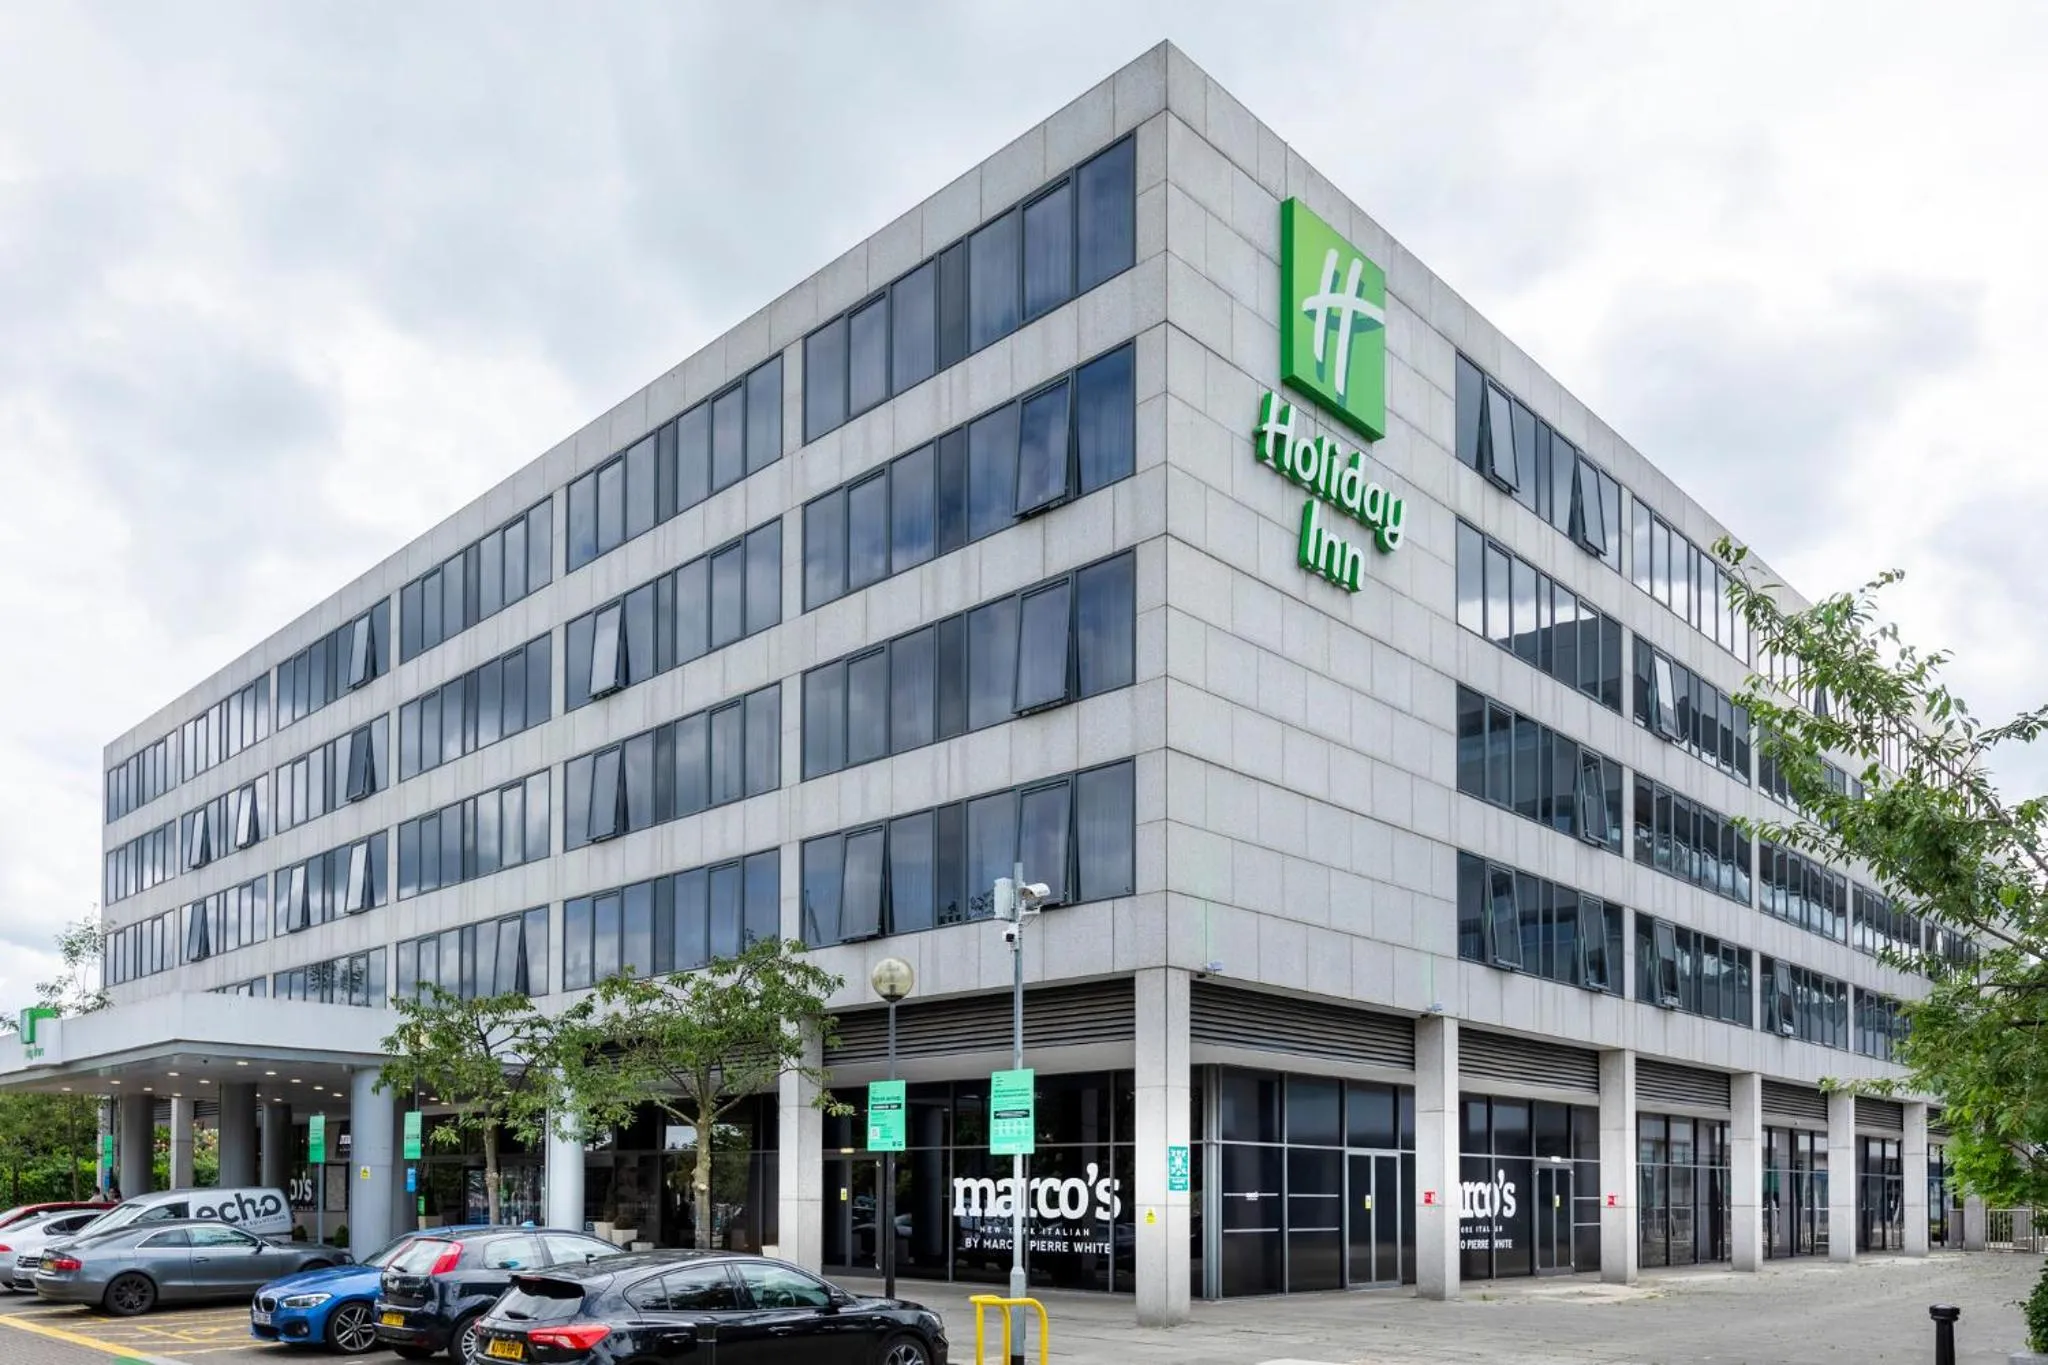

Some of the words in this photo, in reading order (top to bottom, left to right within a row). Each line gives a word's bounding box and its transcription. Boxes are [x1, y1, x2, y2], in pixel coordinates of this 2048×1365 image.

[1254, 390, 1407, 553] Holiday
[1298, 498, 1364, 592] Inn
[196, 1192, 282, 1224] echo
[953, 1162, 1121, 1220] marco's
[1458, 1168, 1516, 1218] rco's
[964, 1237, 980, 1249] BY
[983, 1238, 1013, 1250] MARC
[1030, 1240, 1069, 1252] PIERRE
[1073, 1241, 1111, 1254] WHITE
[1042, 1227, 1090, 1237] ITALIAN
